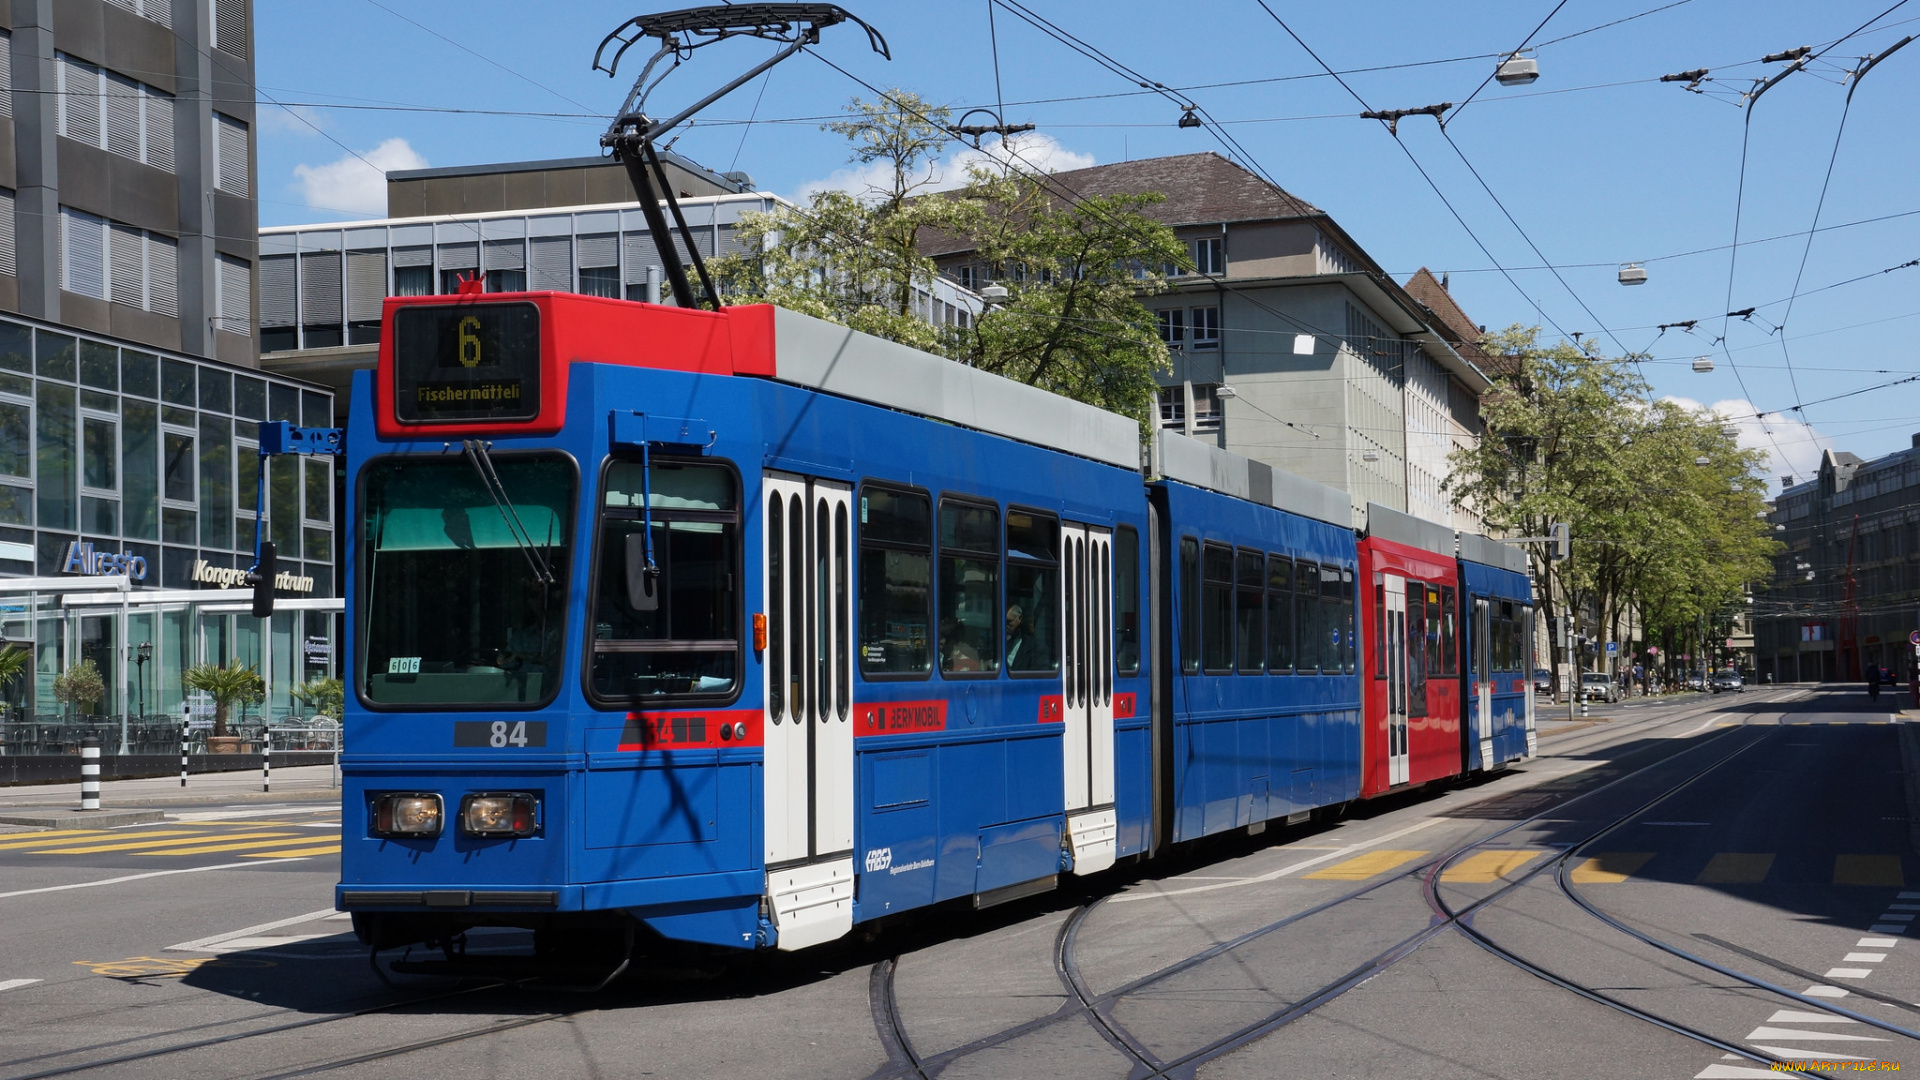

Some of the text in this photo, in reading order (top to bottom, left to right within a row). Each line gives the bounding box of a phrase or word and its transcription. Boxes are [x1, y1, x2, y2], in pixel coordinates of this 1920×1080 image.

[459, 316, 481, 368] 6
[418, 384, 520, 402] Fischermätteli
[63, 541, 148, 580] Allresto
[194, 559, 314, 592] Kongrentrum
[391, 661, 418, 671] 606
[489, 720, 528, 748] 84
